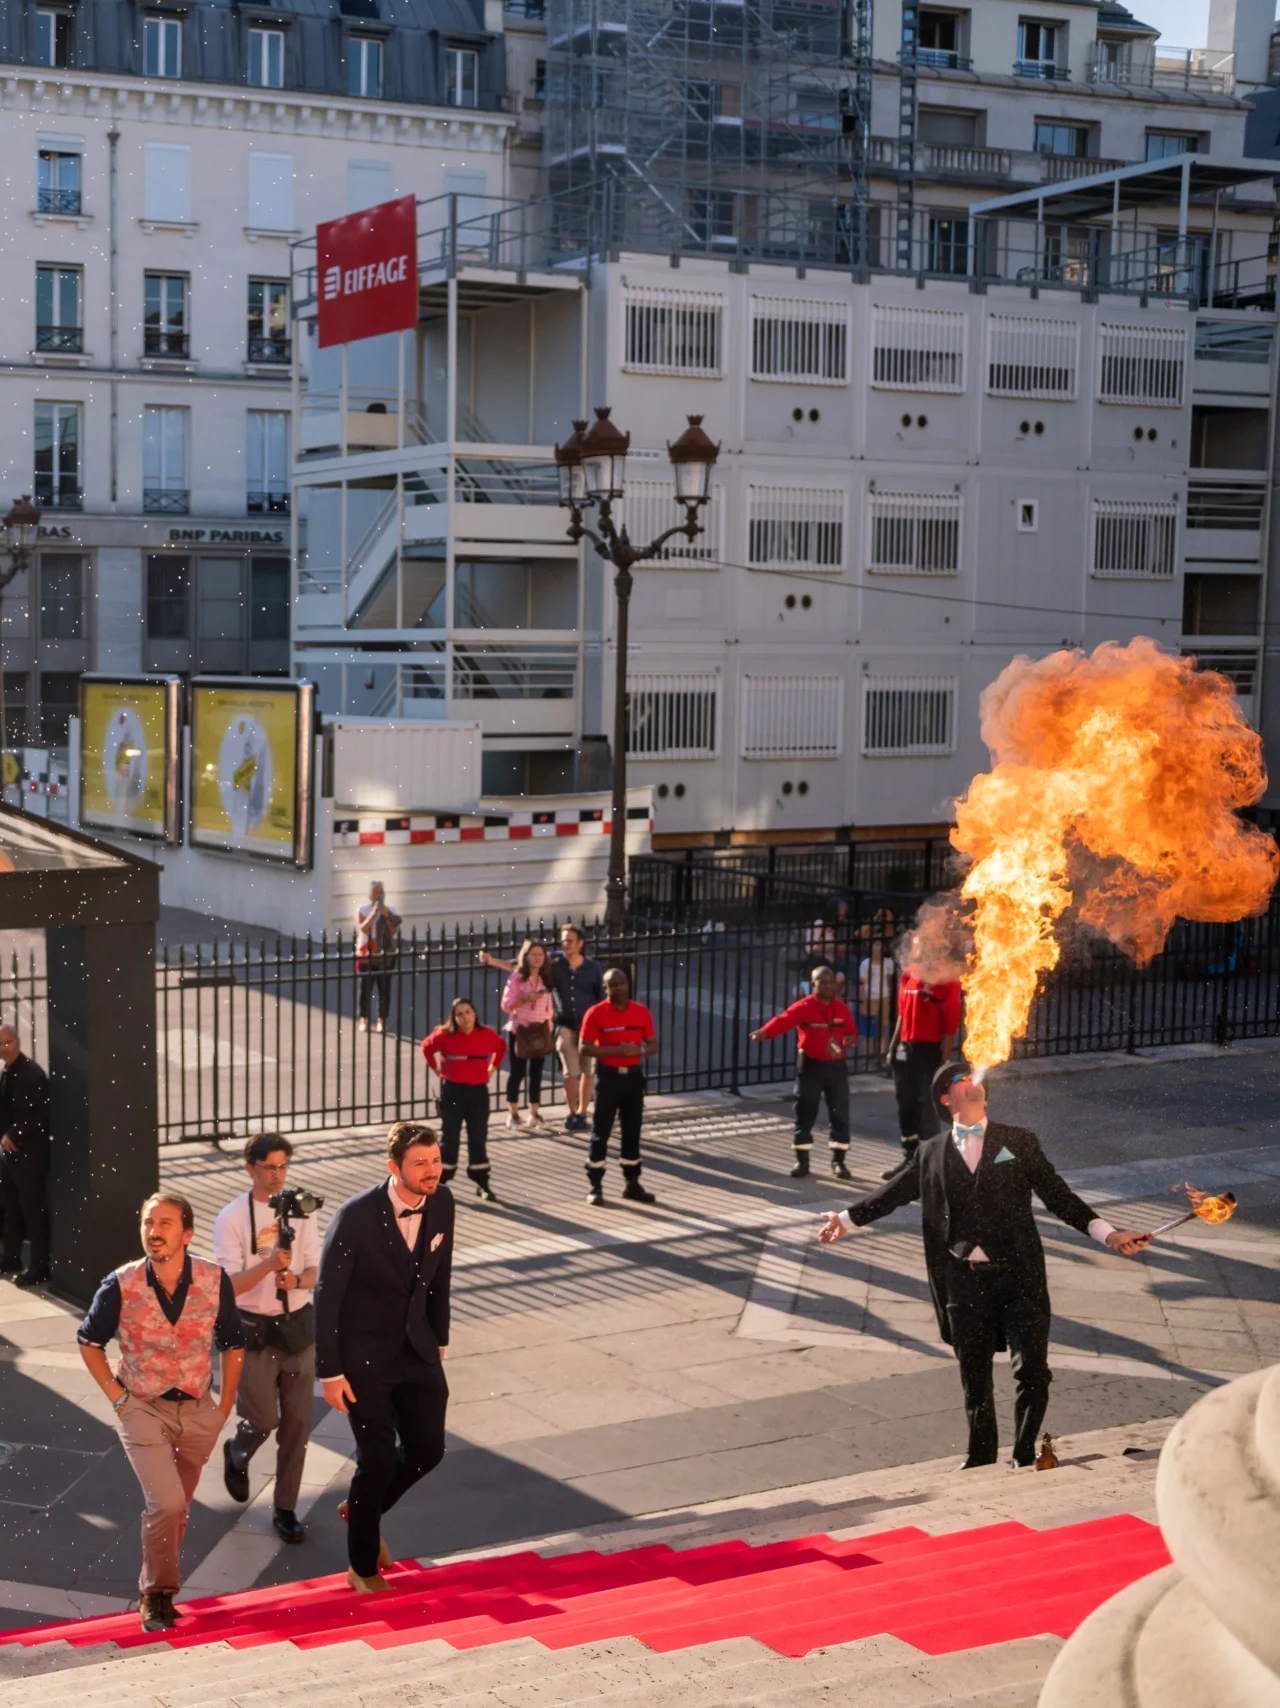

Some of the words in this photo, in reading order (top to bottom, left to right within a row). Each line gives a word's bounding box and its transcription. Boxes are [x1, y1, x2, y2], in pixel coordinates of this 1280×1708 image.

[344, 255, 408, 295] EIFFAGE
[169, 528, 206, 541] BNP
[210, 529, 284, 543] PARIBAS
